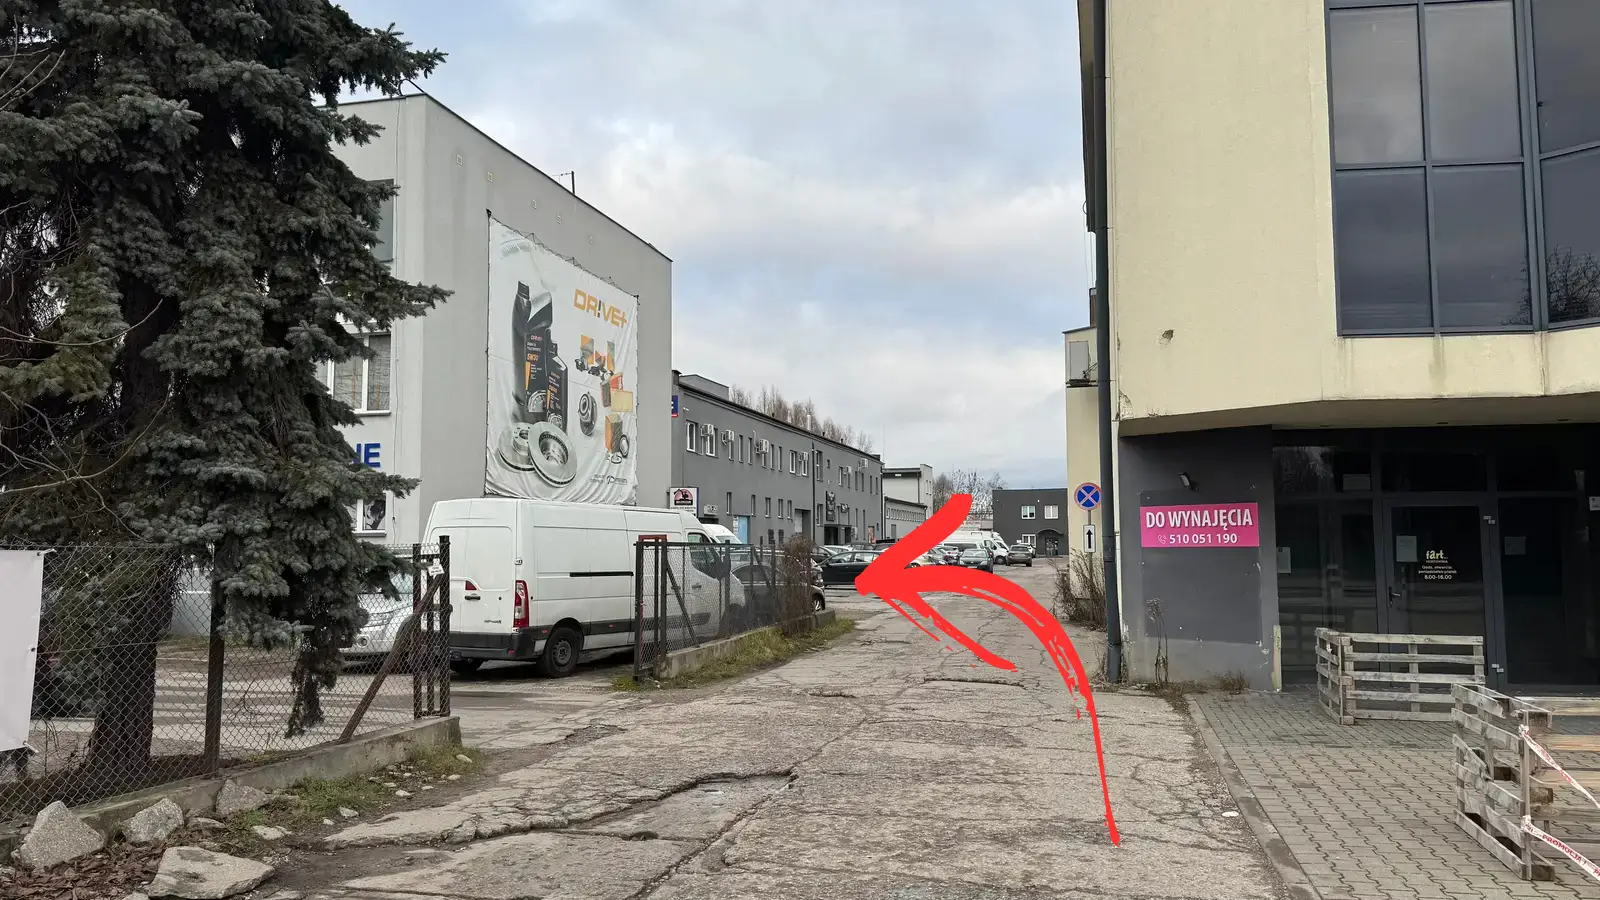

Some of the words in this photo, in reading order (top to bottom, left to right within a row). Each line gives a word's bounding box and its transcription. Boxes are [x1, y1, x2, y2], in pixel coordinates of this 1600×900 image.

[1145, 511, 1165, 529] DO
[1167, 508, 1253, 531] WYNAJĘCIA
[1169, 533, 1190, 544] 510
[1192, 533, 1212, 544] 051
[1216, 533, 1238, 544] 190
[1426, 550, 1444, 559] fart
[1542, 834, 1581, 864] PROMOCJA
